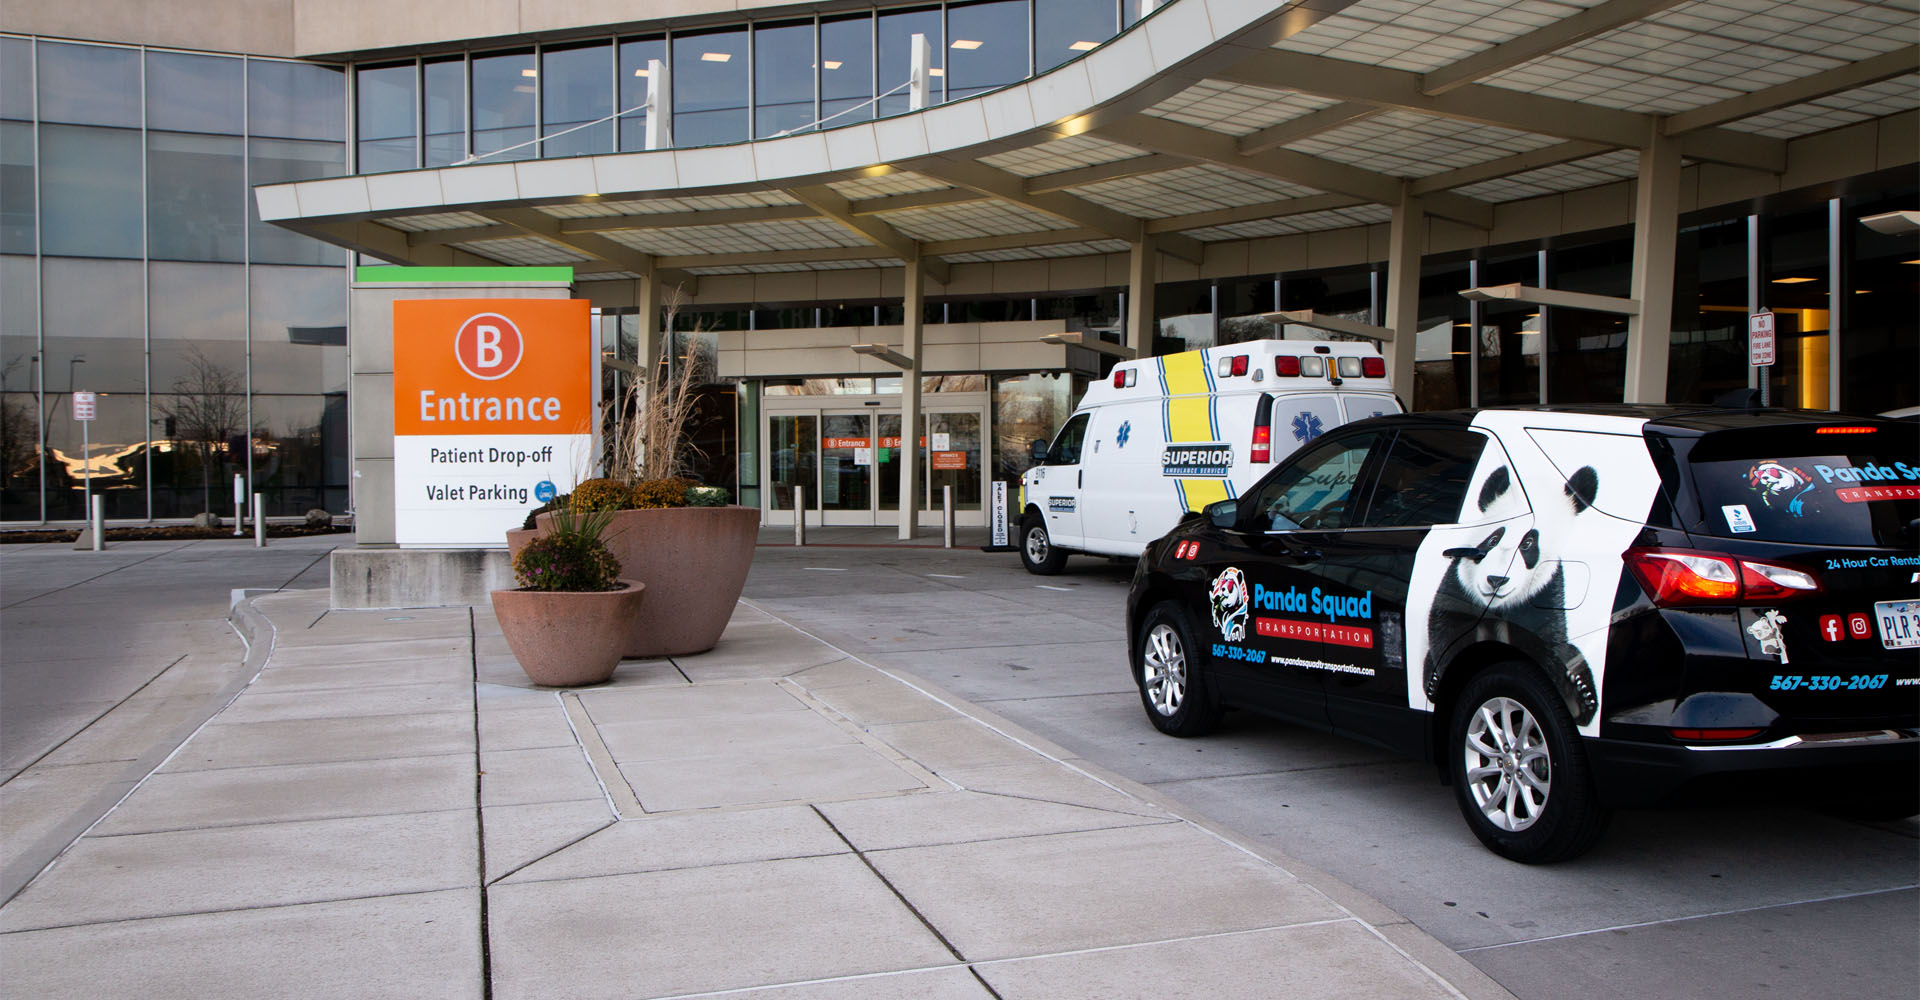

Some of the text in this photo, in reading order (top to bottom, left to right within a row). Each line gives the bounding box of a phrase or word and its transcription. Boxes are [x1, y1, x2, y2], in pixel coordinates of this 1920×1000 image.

[1752, 330, 1771, 338] PARKING
[477, 325, 503, 368] B
[420, 389, 561, 422] Entrance
[838, 440, 866, 448] Entrance
[430, 446, 552, 467] Patient Drop-off
[1162, 450, 1233, 466] SUPERIOR
[1814, 462, 1900, 484] Panda
[426, 483, 528, 504] Valet Parking
[1048, 499, 1076, 507] SUPERIOR
[1826, 560, 1841, 570] 24
[1842, 558, 1868, 569] Hour
[1869, 557, 1888, 567] Car
[1254, 583, 1372, 623] Panda Squad
[1258, 621, 1370, 644] TRANSPORTATION
[1883, 615, 1911, 640] PLR
[1212, 644, 1266, 664] 567-330-2067
[1271, 656, 1375, 676] www.pandasquadtransportation.com
[1769, 674, 1889, 691] 567-330-2067
